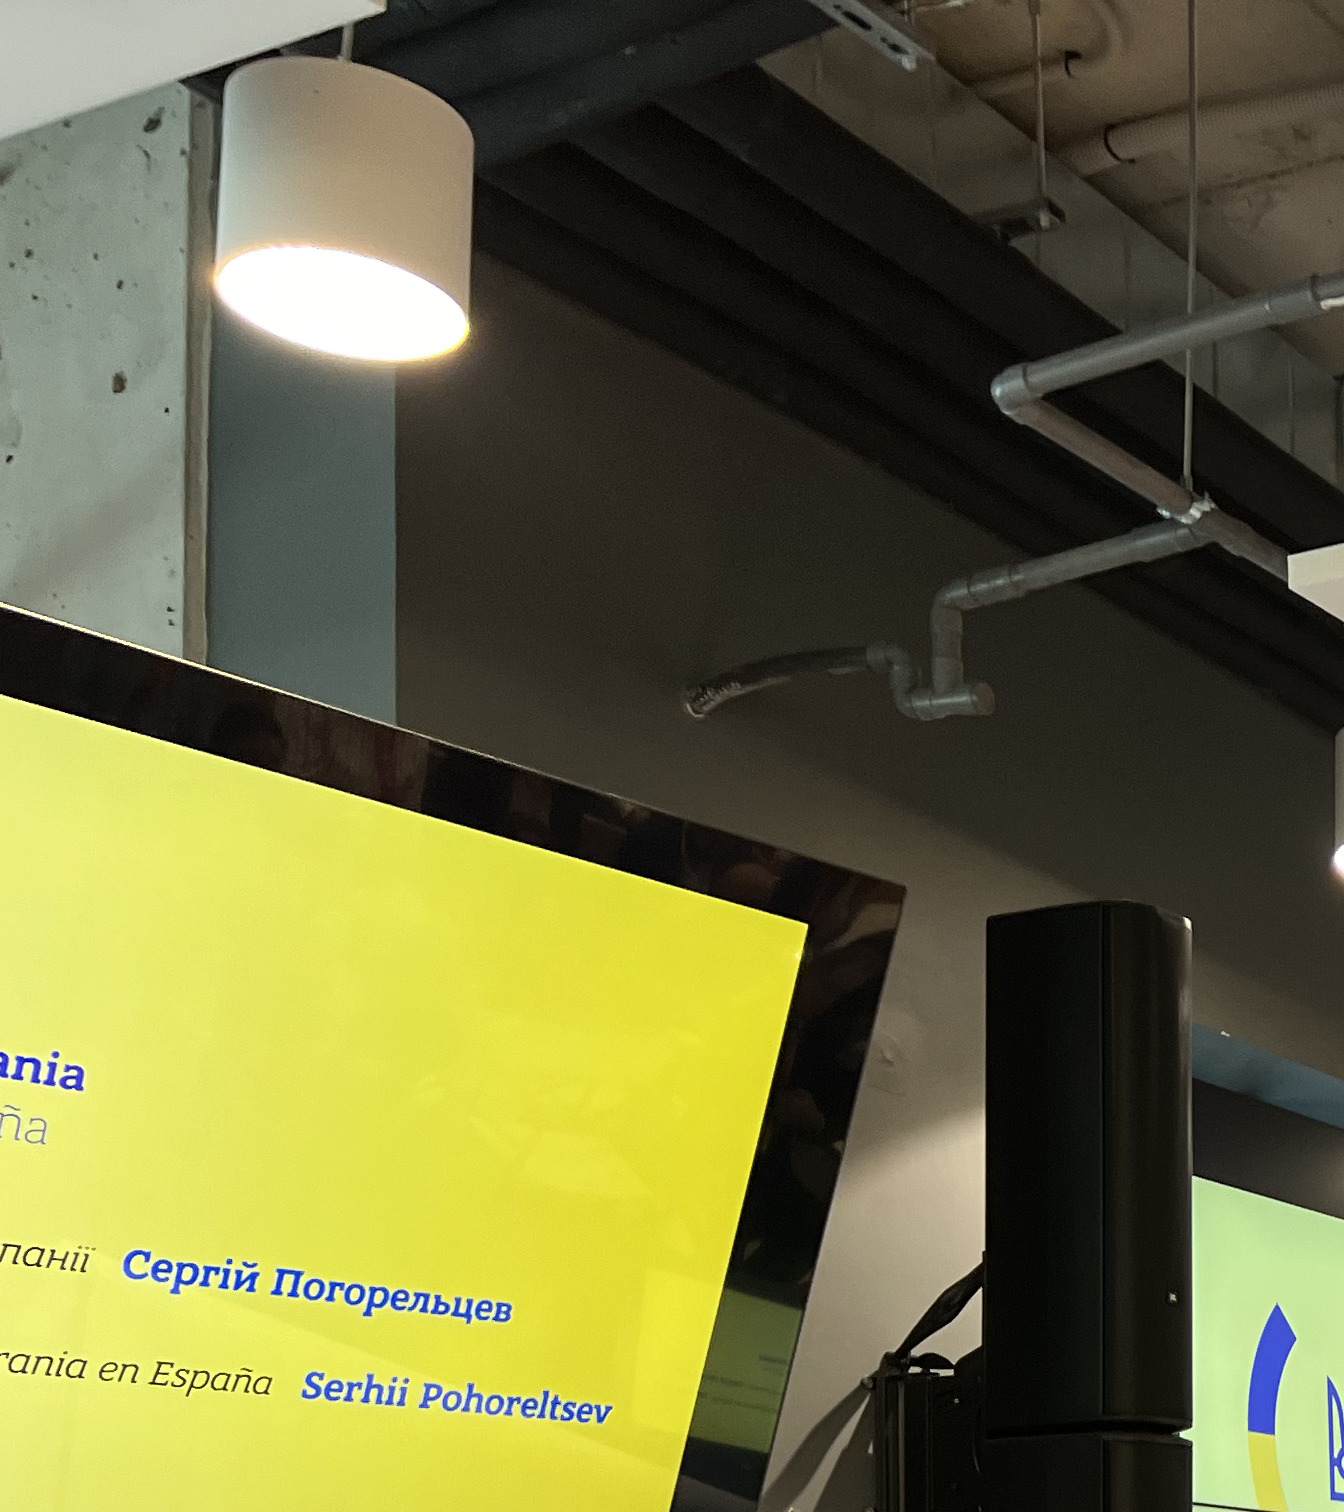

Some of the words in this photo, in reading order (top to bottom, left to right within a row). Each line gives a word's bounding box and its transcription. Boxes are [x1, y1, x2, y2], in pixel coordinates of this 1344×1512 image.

[123, 1250, 260, 1294] Сергій
[271, 1268, 512, 1324] Погорельцев
[99, 1361, 139, 1384] en
[149, 1361, 273, 1397] España
[302, 1371, 409, 1408] Serhii
[419, 1382, 612, 1425] Pohoreltsev
